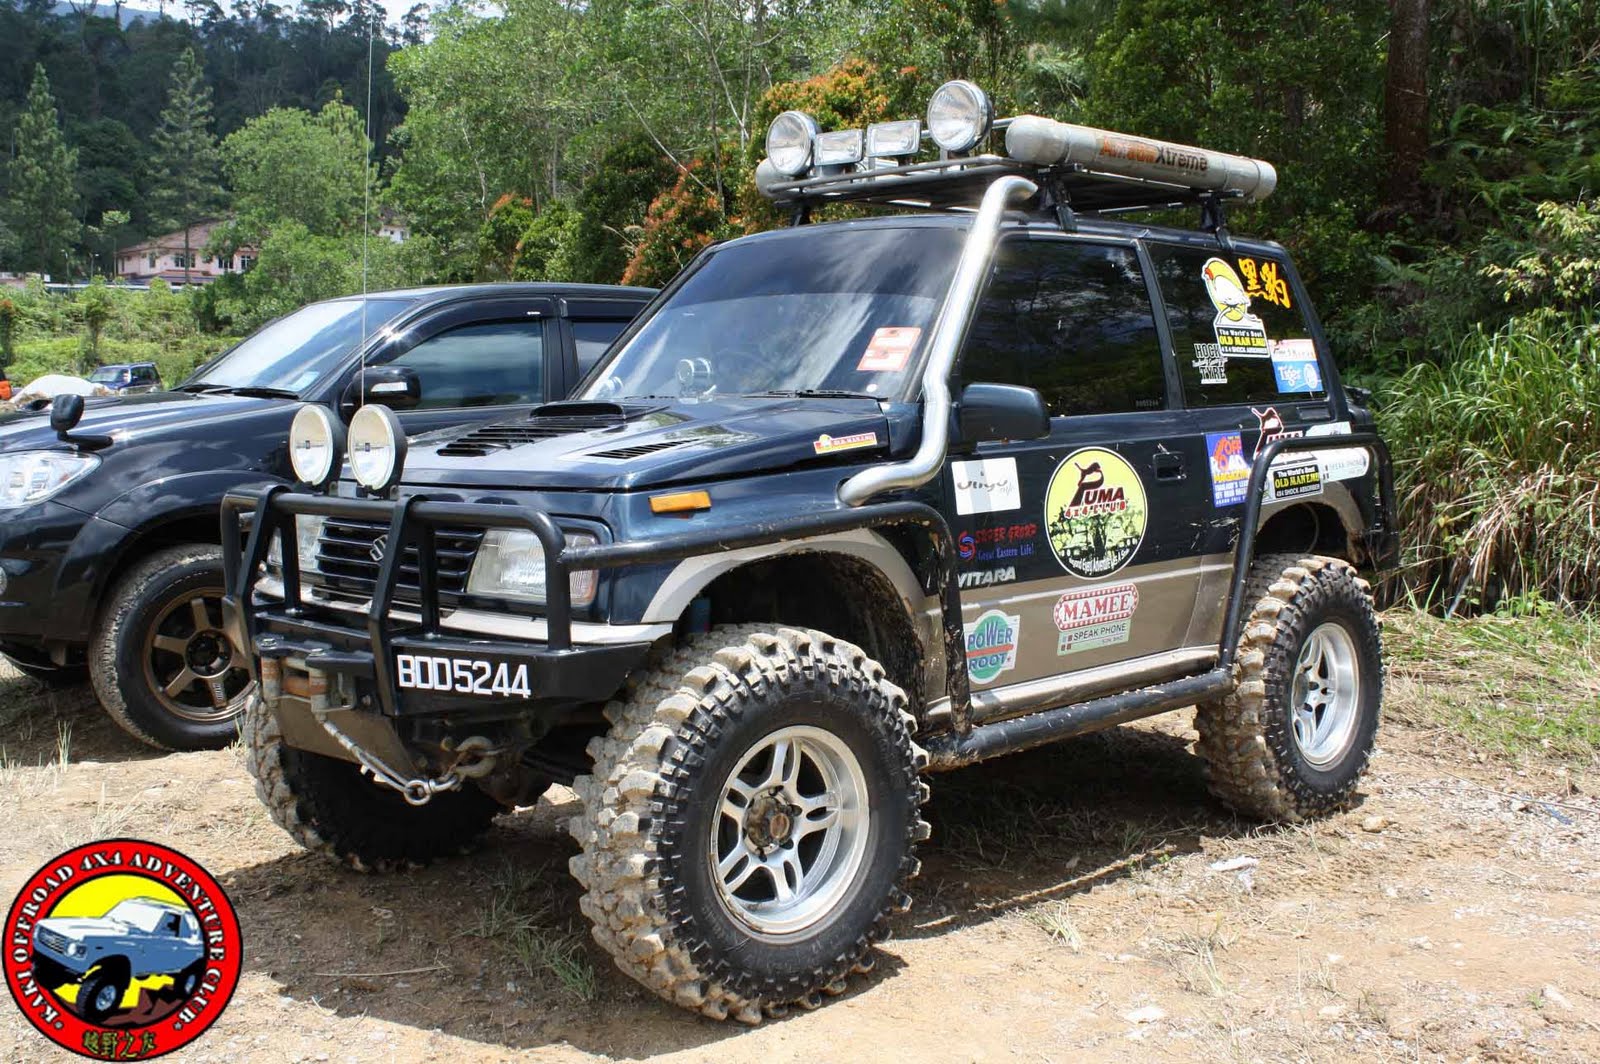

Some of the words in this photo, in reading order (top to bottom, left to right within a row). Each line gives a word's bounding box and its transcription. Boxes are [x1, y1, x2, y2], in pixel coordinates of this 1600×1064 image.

[1219, 335, 1234, 346] OLD
[1234, 336, 1251, 347] MAN
[1069, 462, 1125, 509] PUMA
[1274, 478, 1289, 489] OLD
[1290, 475, 1306, 486] MAN
[1306, 472, 1320, 483] EMU
[996, 547, 1018, 558] Eastern
[957, 566, 1016, 588] VITARA
[1063, 593, 1131, 621] MAMEE
[1073, 628, 1099, 641] SPEAK
[1100, 622, 1127, 635] PHONE
[968, 652, 1007, 670] ROOT
